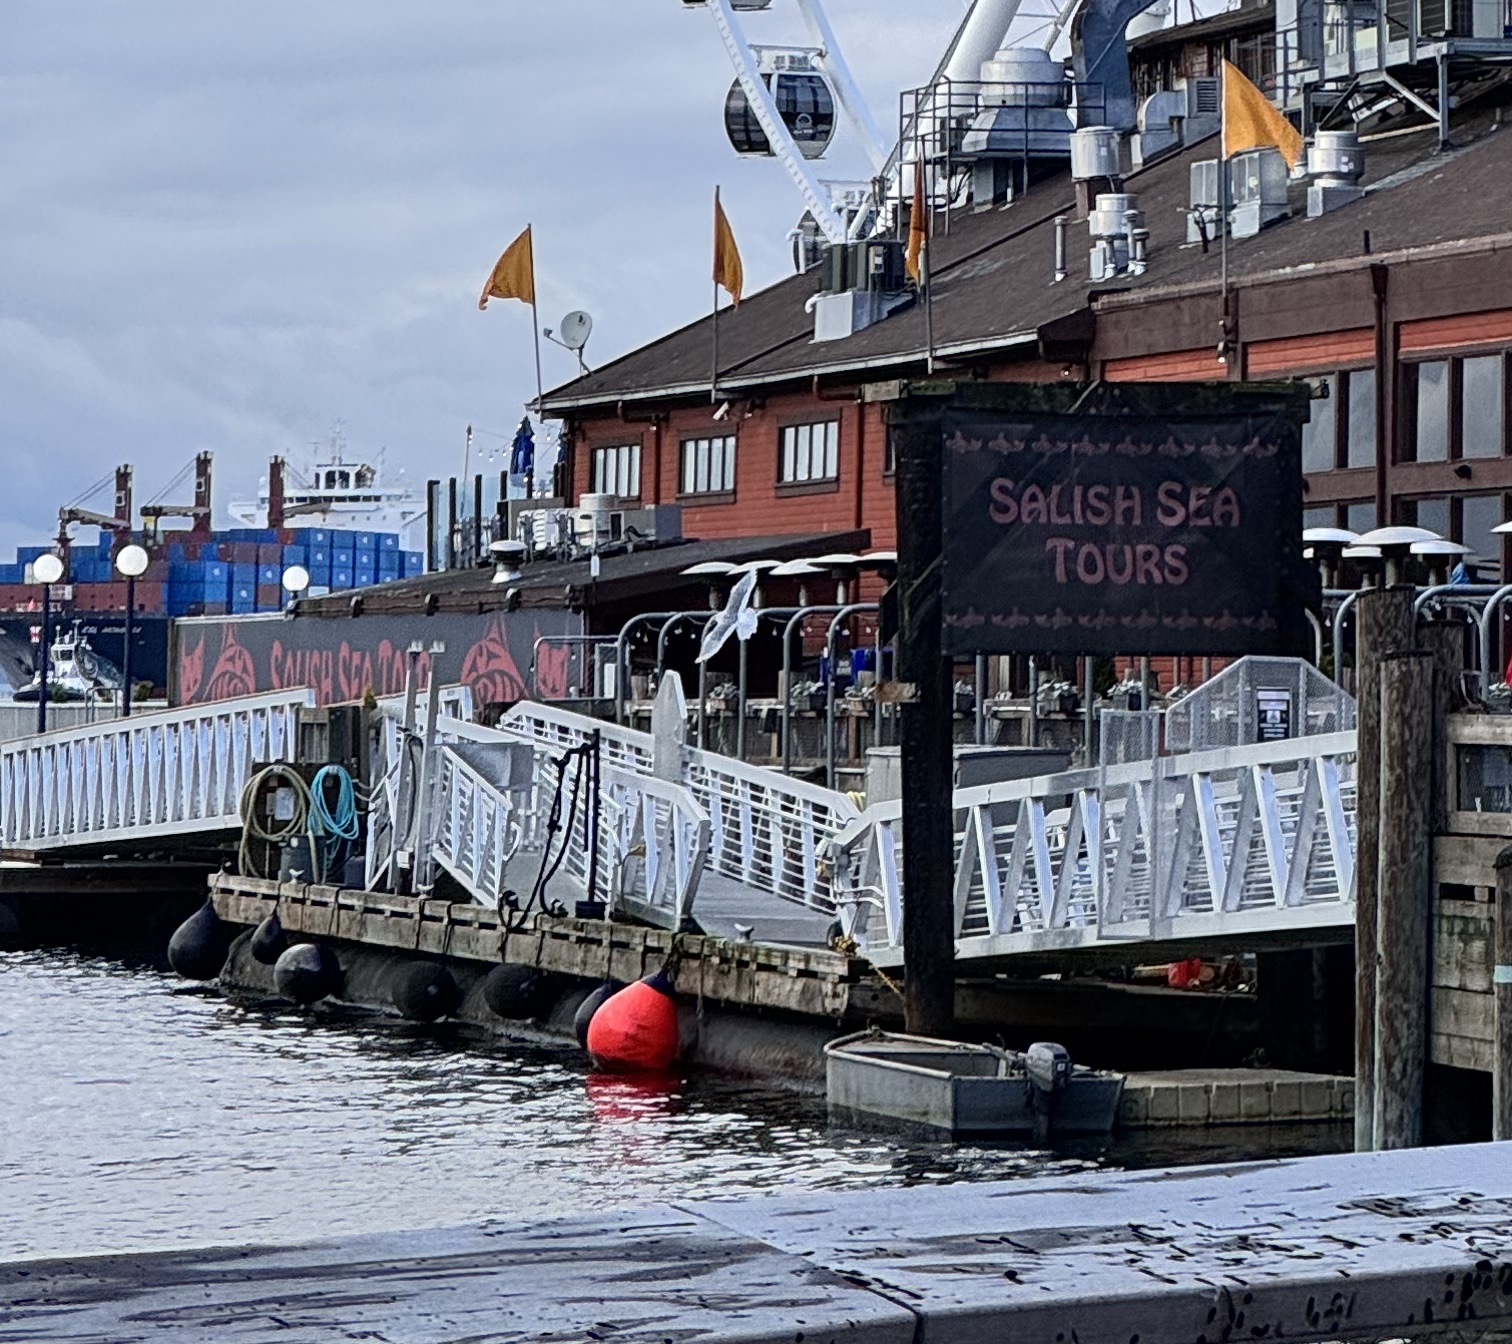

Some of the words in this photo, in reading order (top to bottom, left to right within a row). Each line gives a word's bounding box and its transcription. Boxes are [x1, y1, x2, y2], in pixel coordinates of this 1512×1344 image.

[988, 477, 1142, 526] SALISH
[1156, 480, 1241, 528] SEA
[1045, 536, 1189, 585] TOURS
